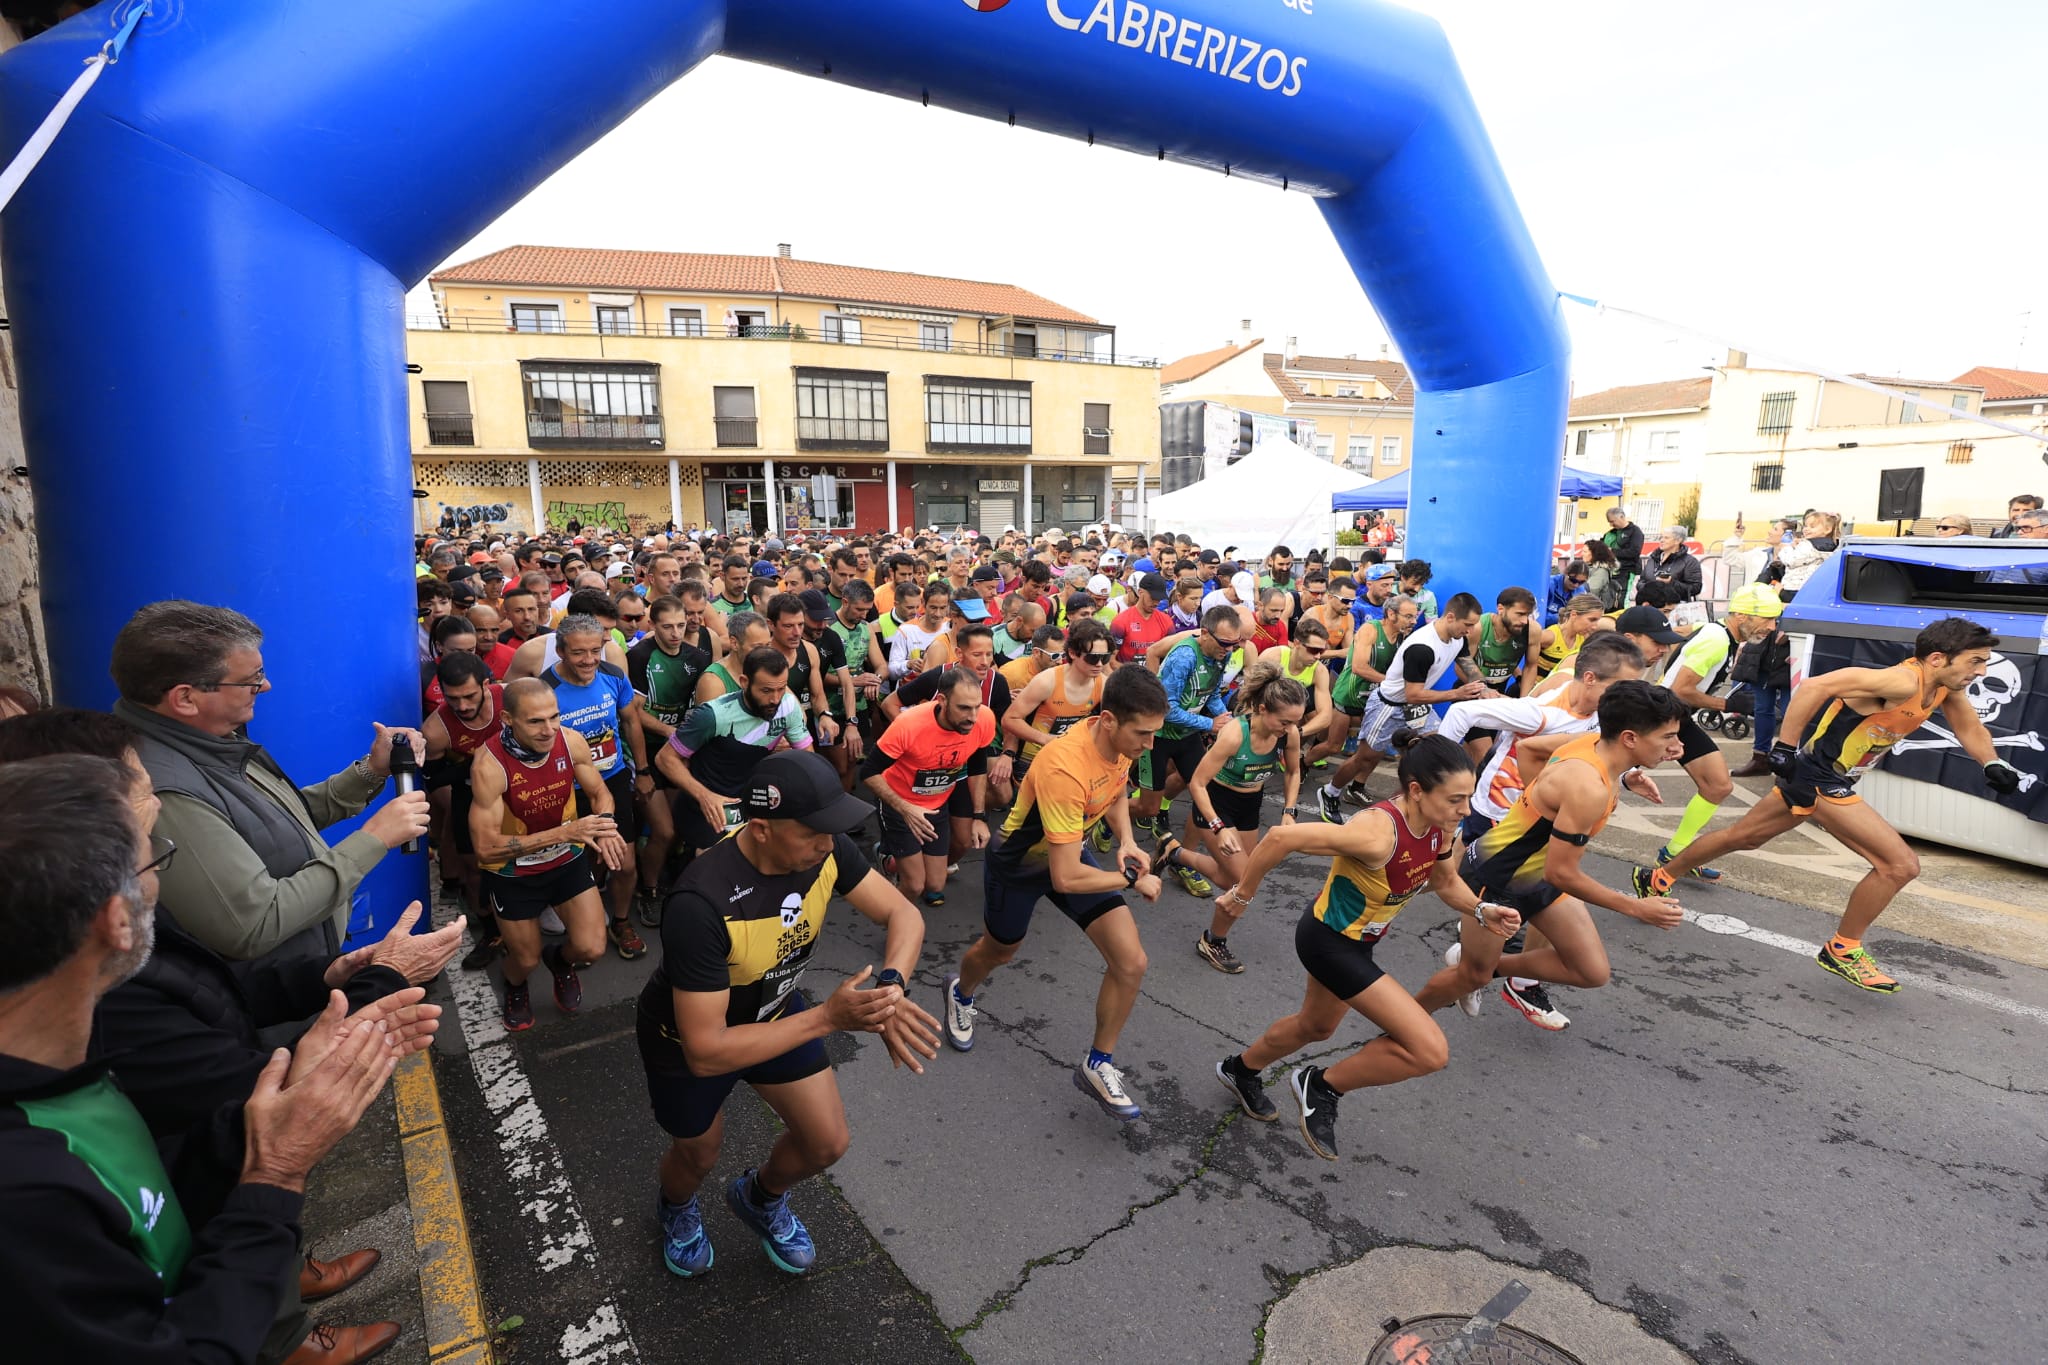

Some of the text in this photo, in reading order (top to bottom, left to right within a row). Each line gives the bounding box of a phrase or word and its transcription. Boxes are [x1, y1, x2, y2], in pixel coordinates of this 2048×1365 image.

[1046, 0, 1308, 97] CABRERIZOS
[726, 465, 847, 478] KISCAR
[560, 704, 600, 721] COMERCIAL
[572, 710, 609, 726] ATLETISMO
[658, 713, 679, 724] 128
[924, 775, 950, 786] 512
[532, 793, 557, 808] VINO
[776, 931, 810, 960] CROSS
[774, 968, 791, 979] LIGA
